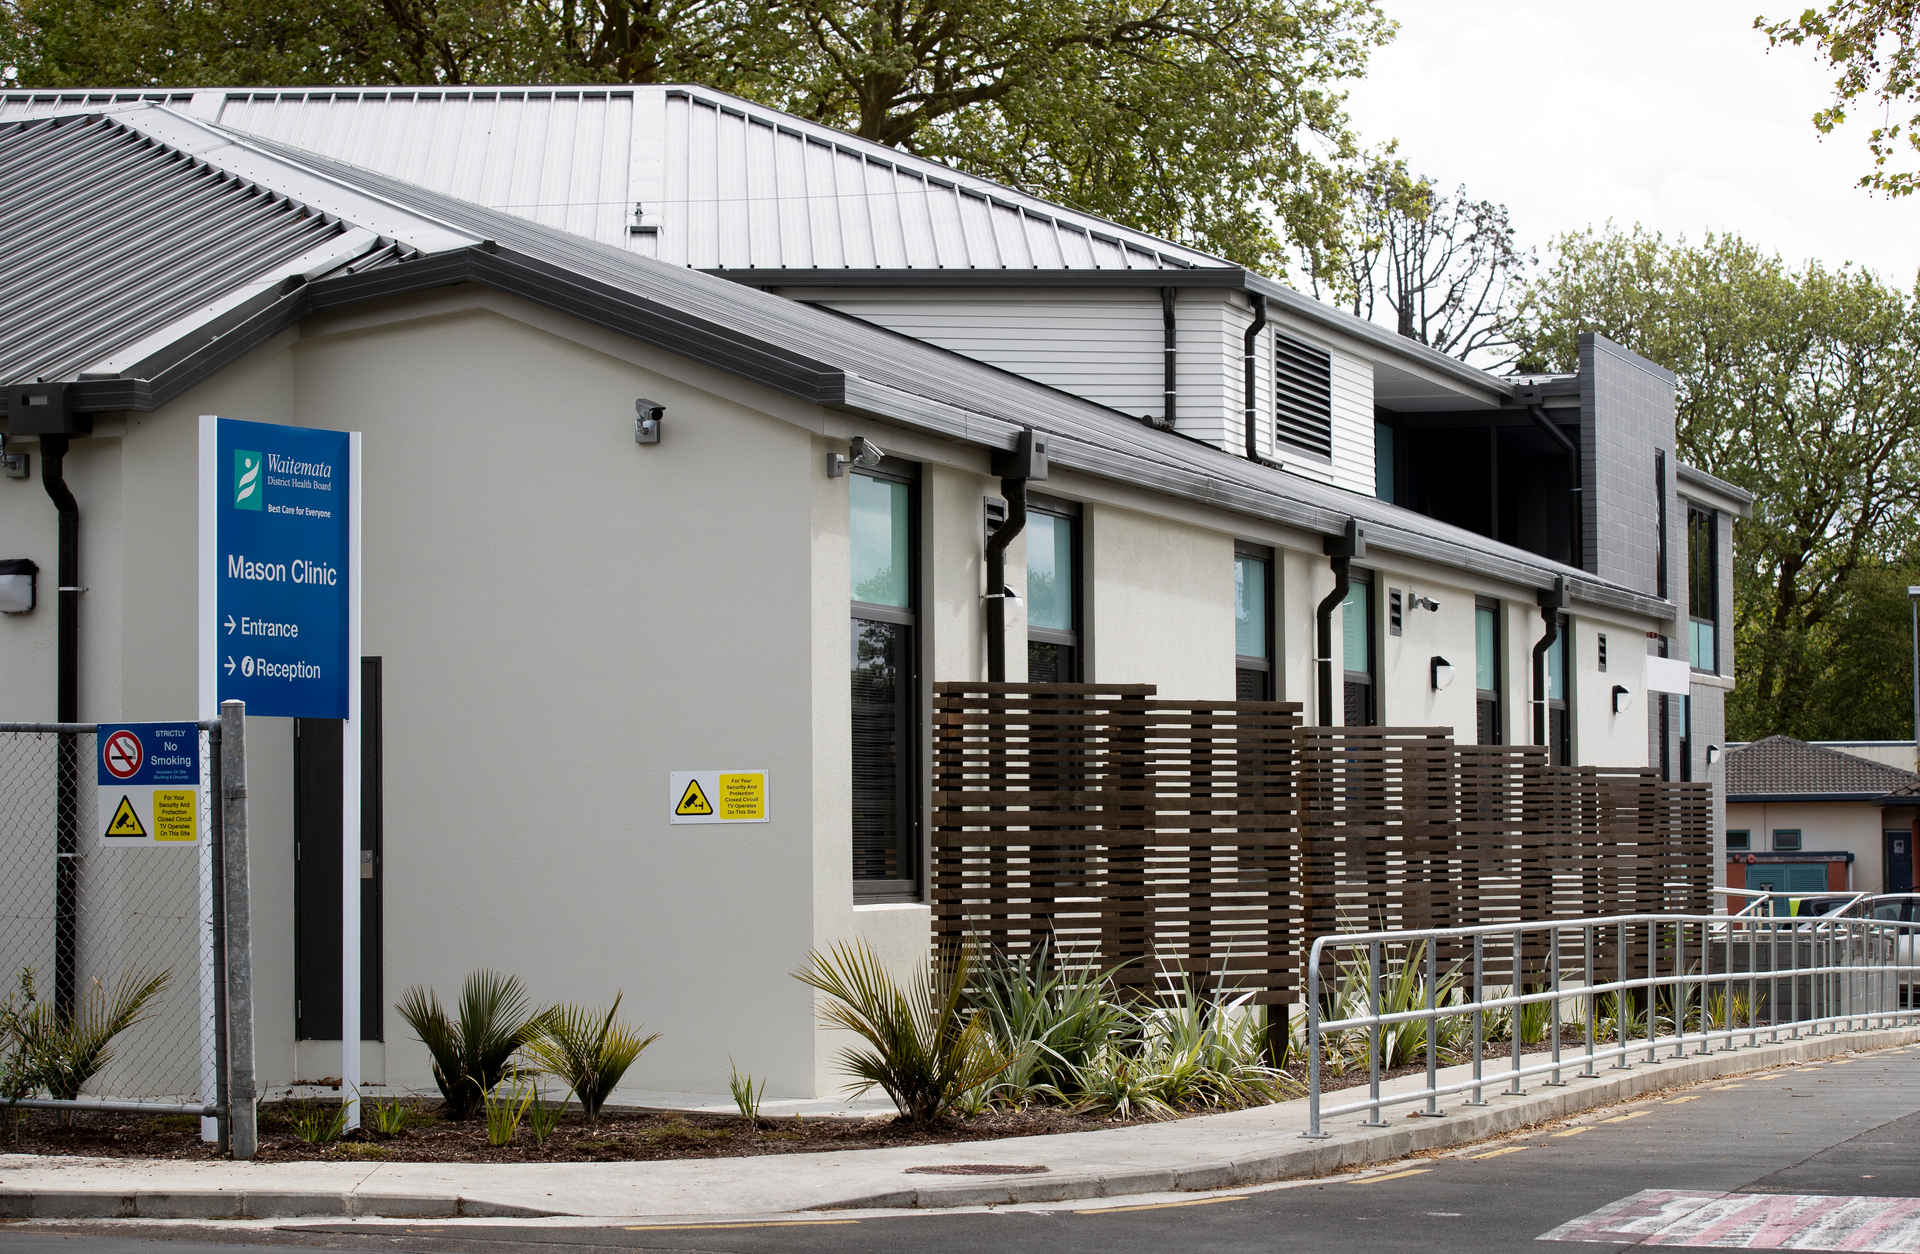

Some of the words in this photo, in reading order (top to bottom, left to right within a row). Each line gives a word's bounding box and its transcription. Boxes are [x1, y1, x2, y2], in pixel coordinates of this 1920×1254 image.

[267, 453, 331, 478] Waitemata
[267, 476, 290, 487] District
[292, 478, 312, 489] Health
[313, 480, 331, 491] Board
[268, 504, 280, 513] Best
[282, 505, 295, 515] Care
[296, 506, 304, 516] for
[306, 508, 331, 519] Everyone
[228, 554, 286, 582] Mason
[291, 559, 337, 586] Clinic
[241, 616, 299, 638] Entrance
[256, 658, 320, 682] Reception
[164, 742, 178, 751] No
[150, 755, 191, 767] Smoking
